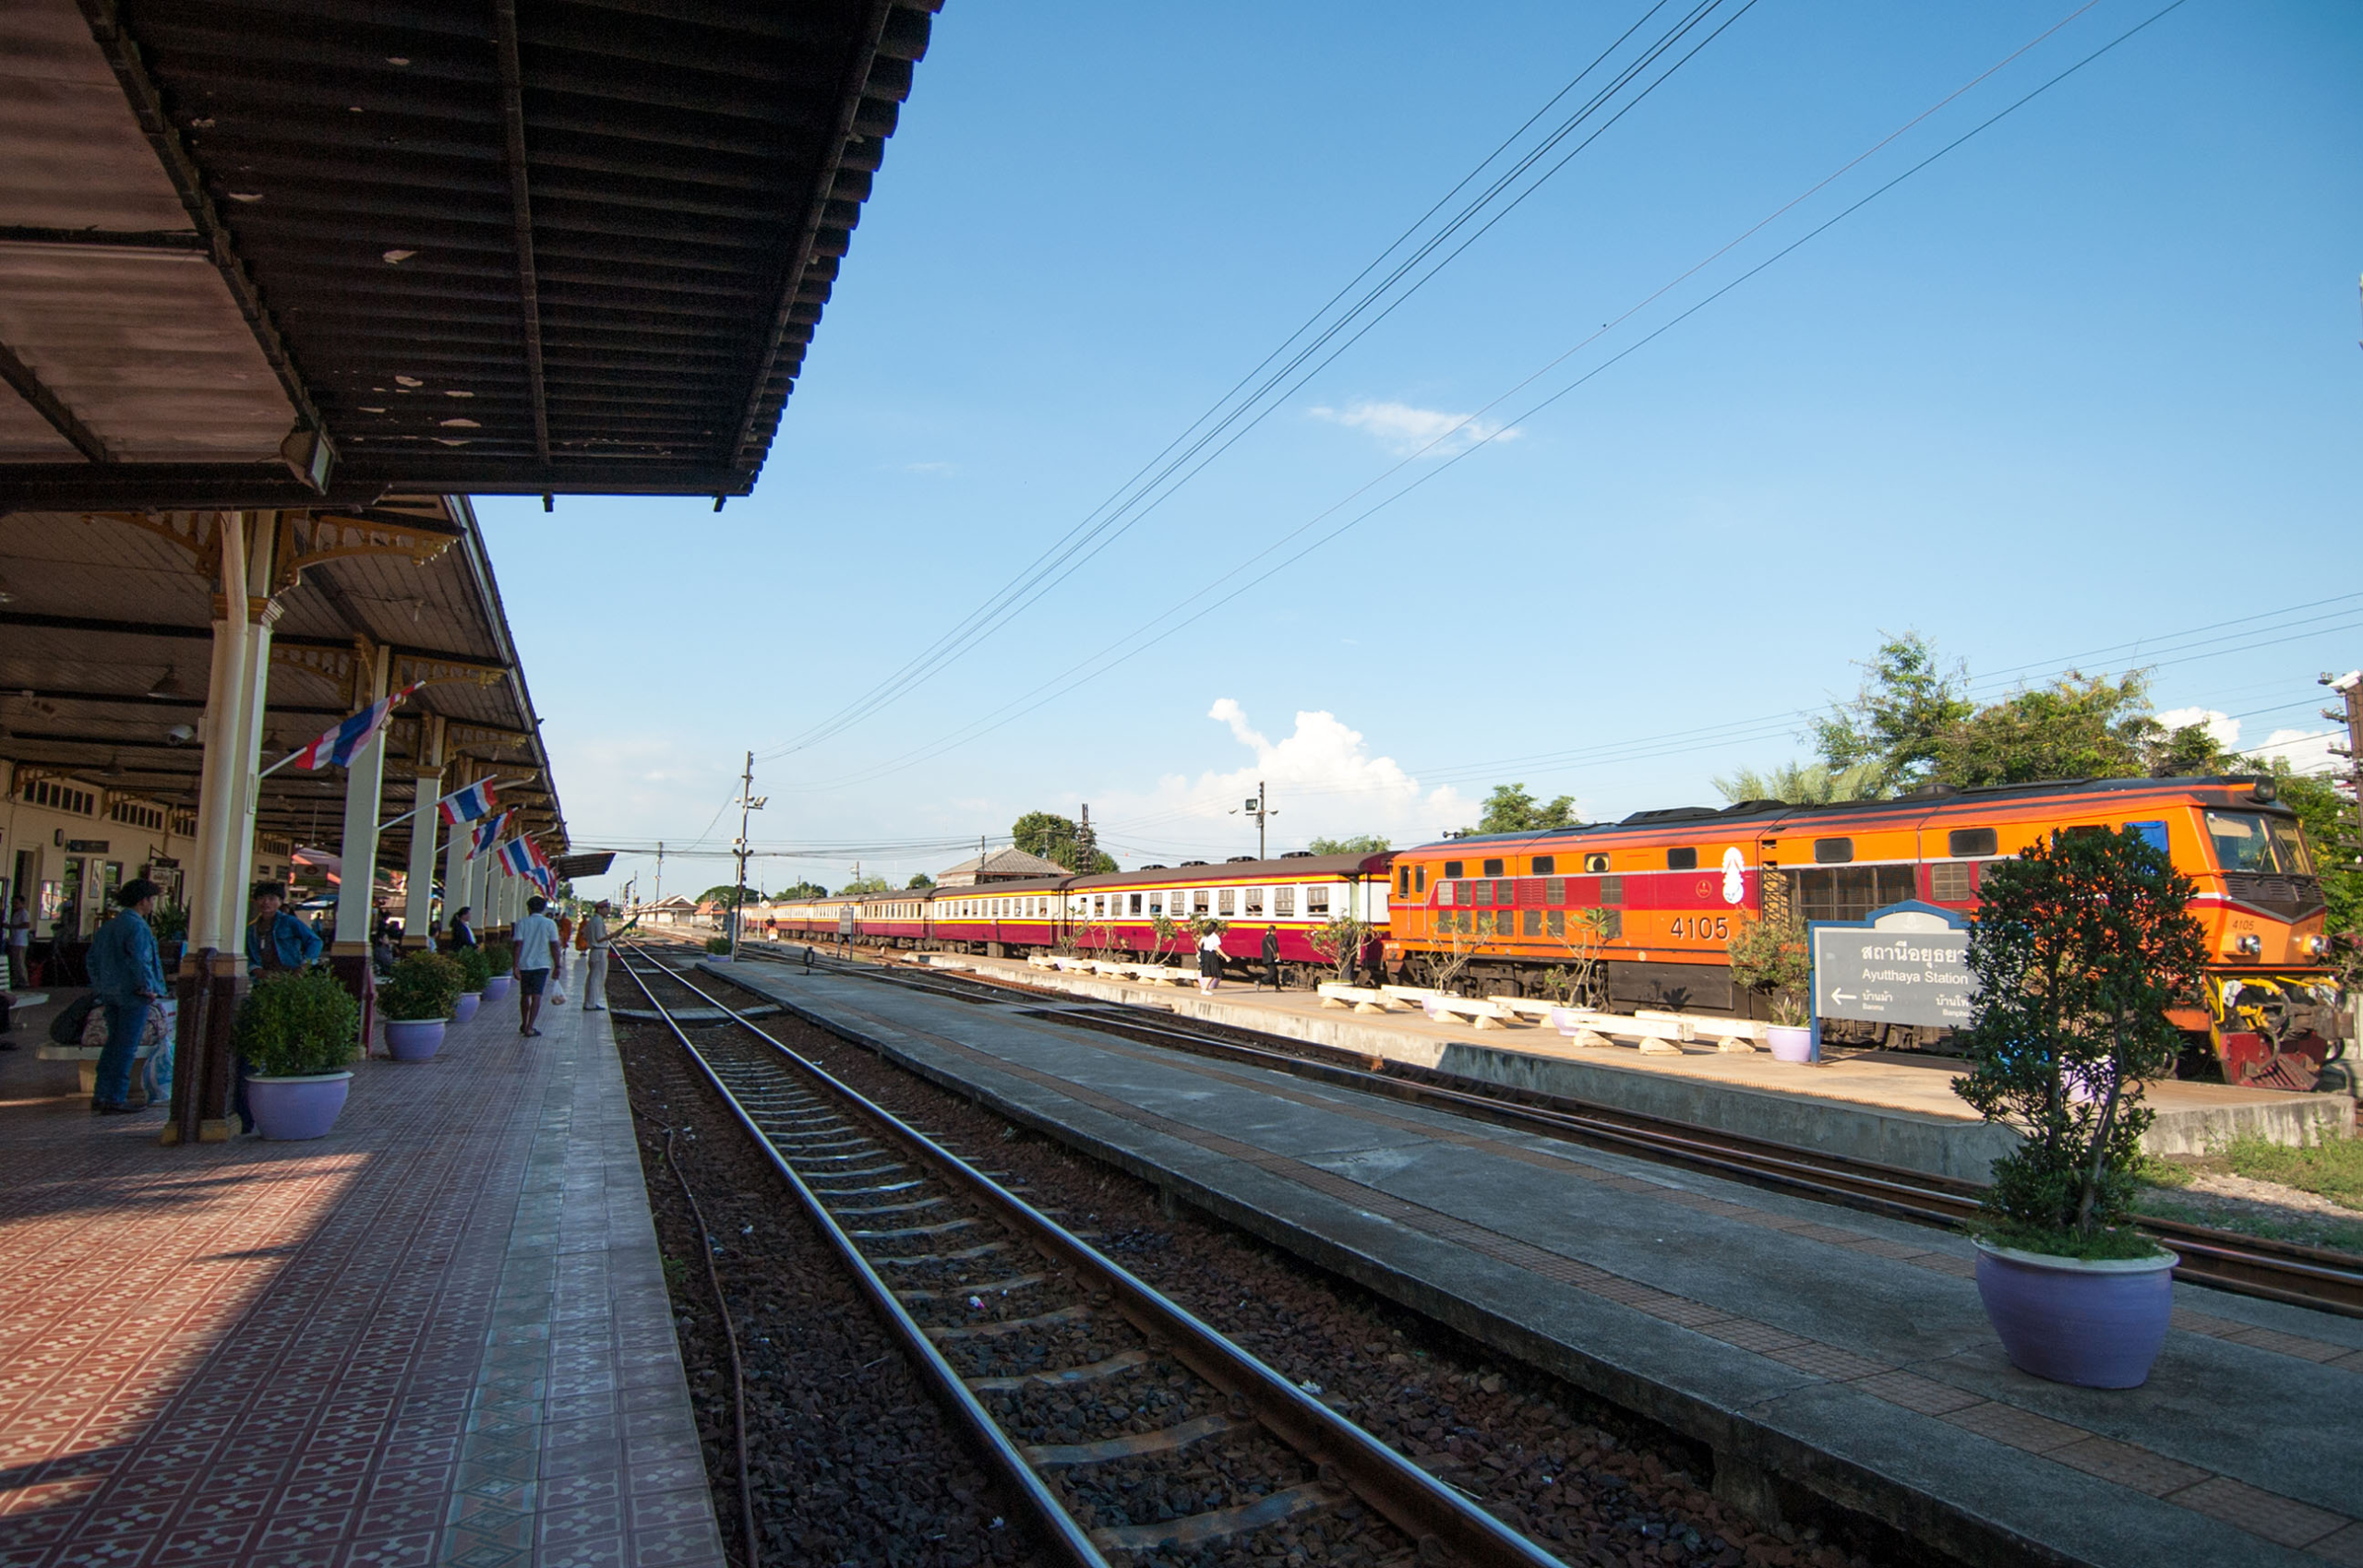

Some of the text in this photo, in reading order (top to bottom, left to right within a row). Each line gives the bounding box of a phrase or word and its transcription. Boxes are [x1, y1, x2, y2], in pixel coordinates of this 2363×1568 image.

[1671, 916, 1730, 940] 4105
[2232, 919, 2255, 931] 4105
[1862, 968, 1969, 985] Ayutthaya Station
